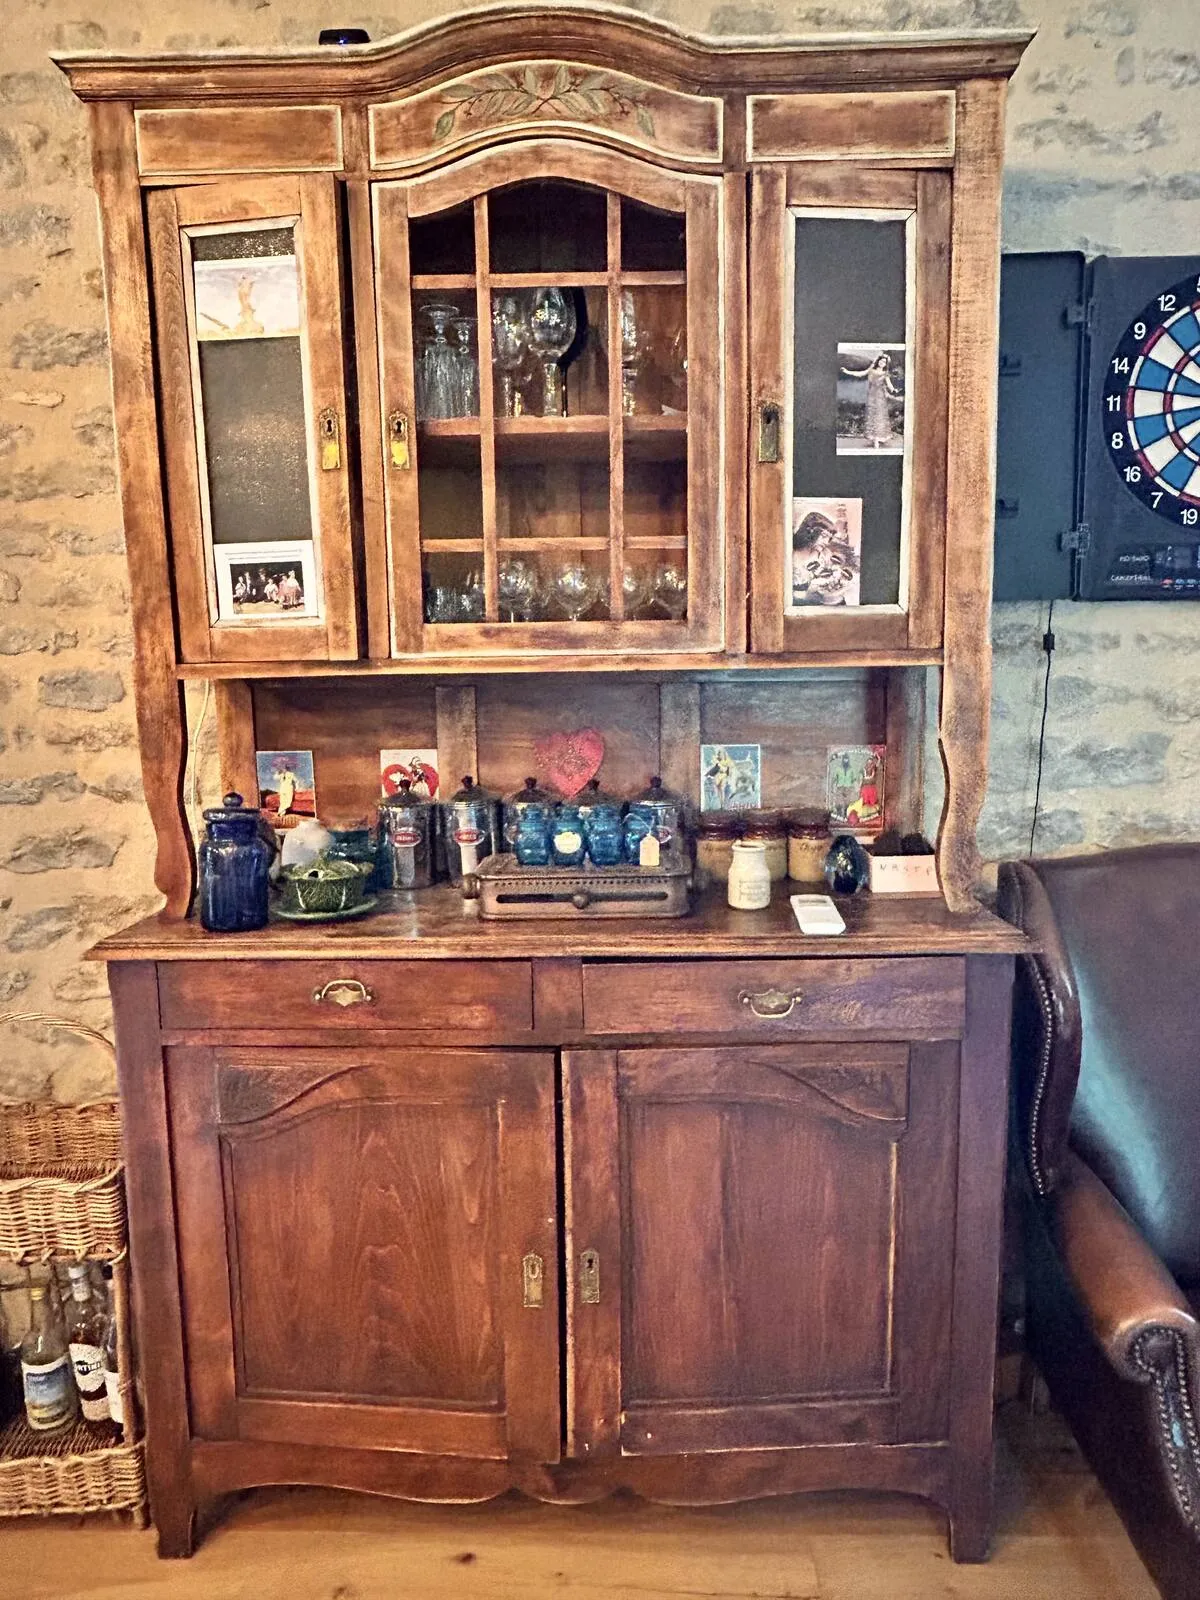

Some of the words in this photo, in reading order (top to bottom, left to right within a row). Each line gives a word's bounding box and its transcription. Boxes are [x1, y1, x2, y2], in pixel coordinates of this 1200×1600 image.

[1157, 294, 1177, 312] 12
[1133, 321, 1147, 340] 9
[1111, 357, 1130, 375] 14
[1106, 394, 1121, 412] 11
[1111, 431, 1124, 450] 8
[1123, 465, 1142, 483] 16
[1150, 491, 1164, 509] 7
[1180, 508, 1199, 525] 19
